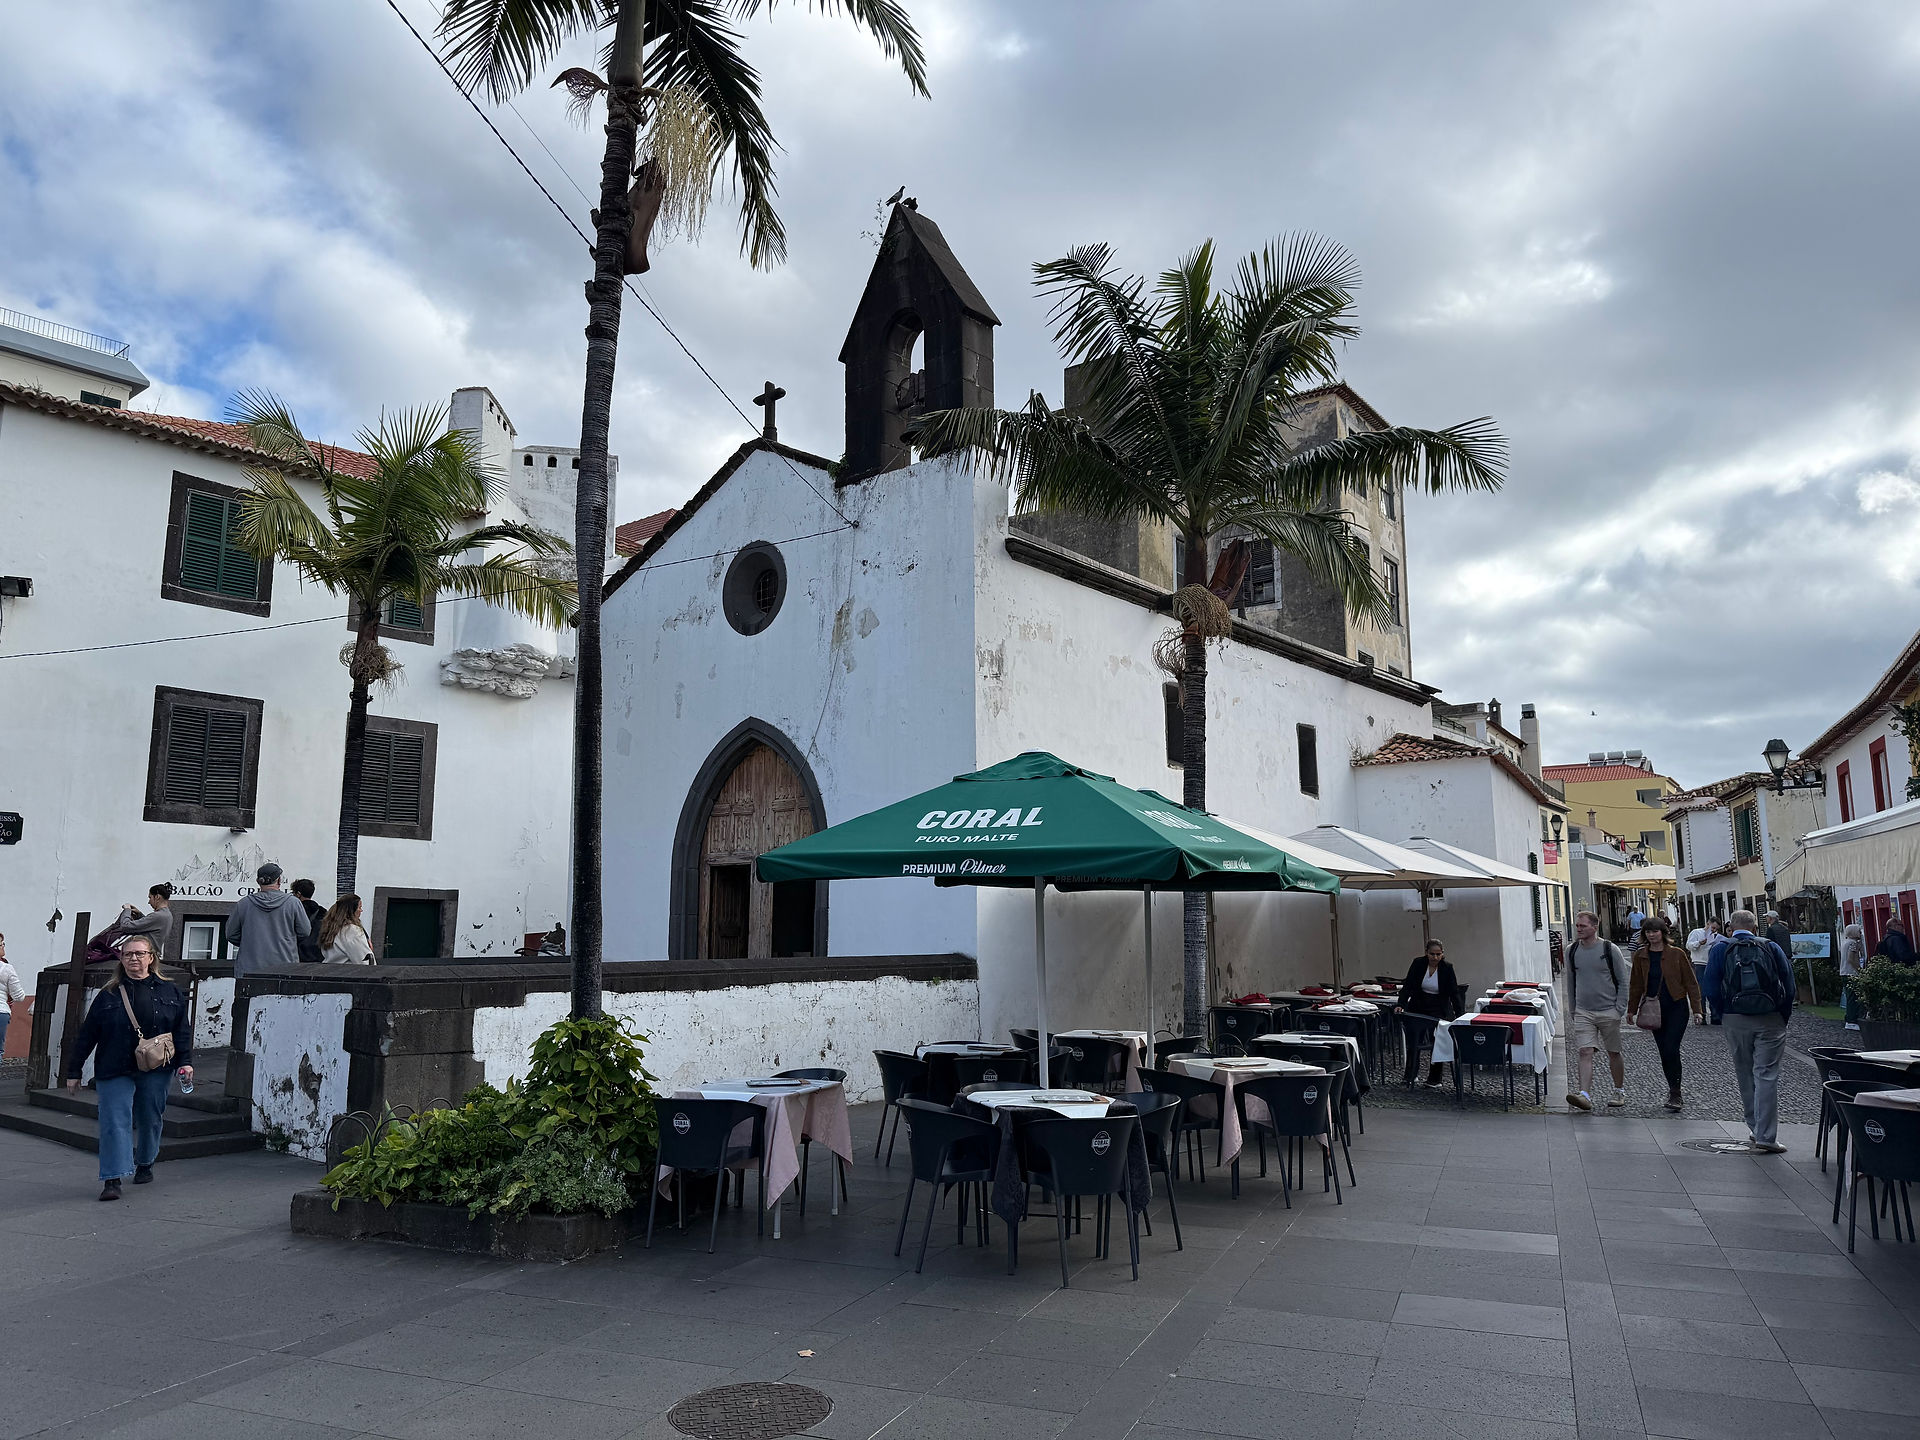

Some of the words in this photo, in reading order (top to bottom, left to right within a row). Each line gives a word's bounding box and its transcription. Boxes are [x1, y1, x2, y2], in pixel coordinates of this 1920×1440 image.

[916, 806, 1044, 829] CORAL
[915, 835, 960, 843] PURO
[963, 833, 1019, 843] MALTE
[902, 863, 956, 874] PREMIUM
[959, 858, 1007, 875] Pilsner
